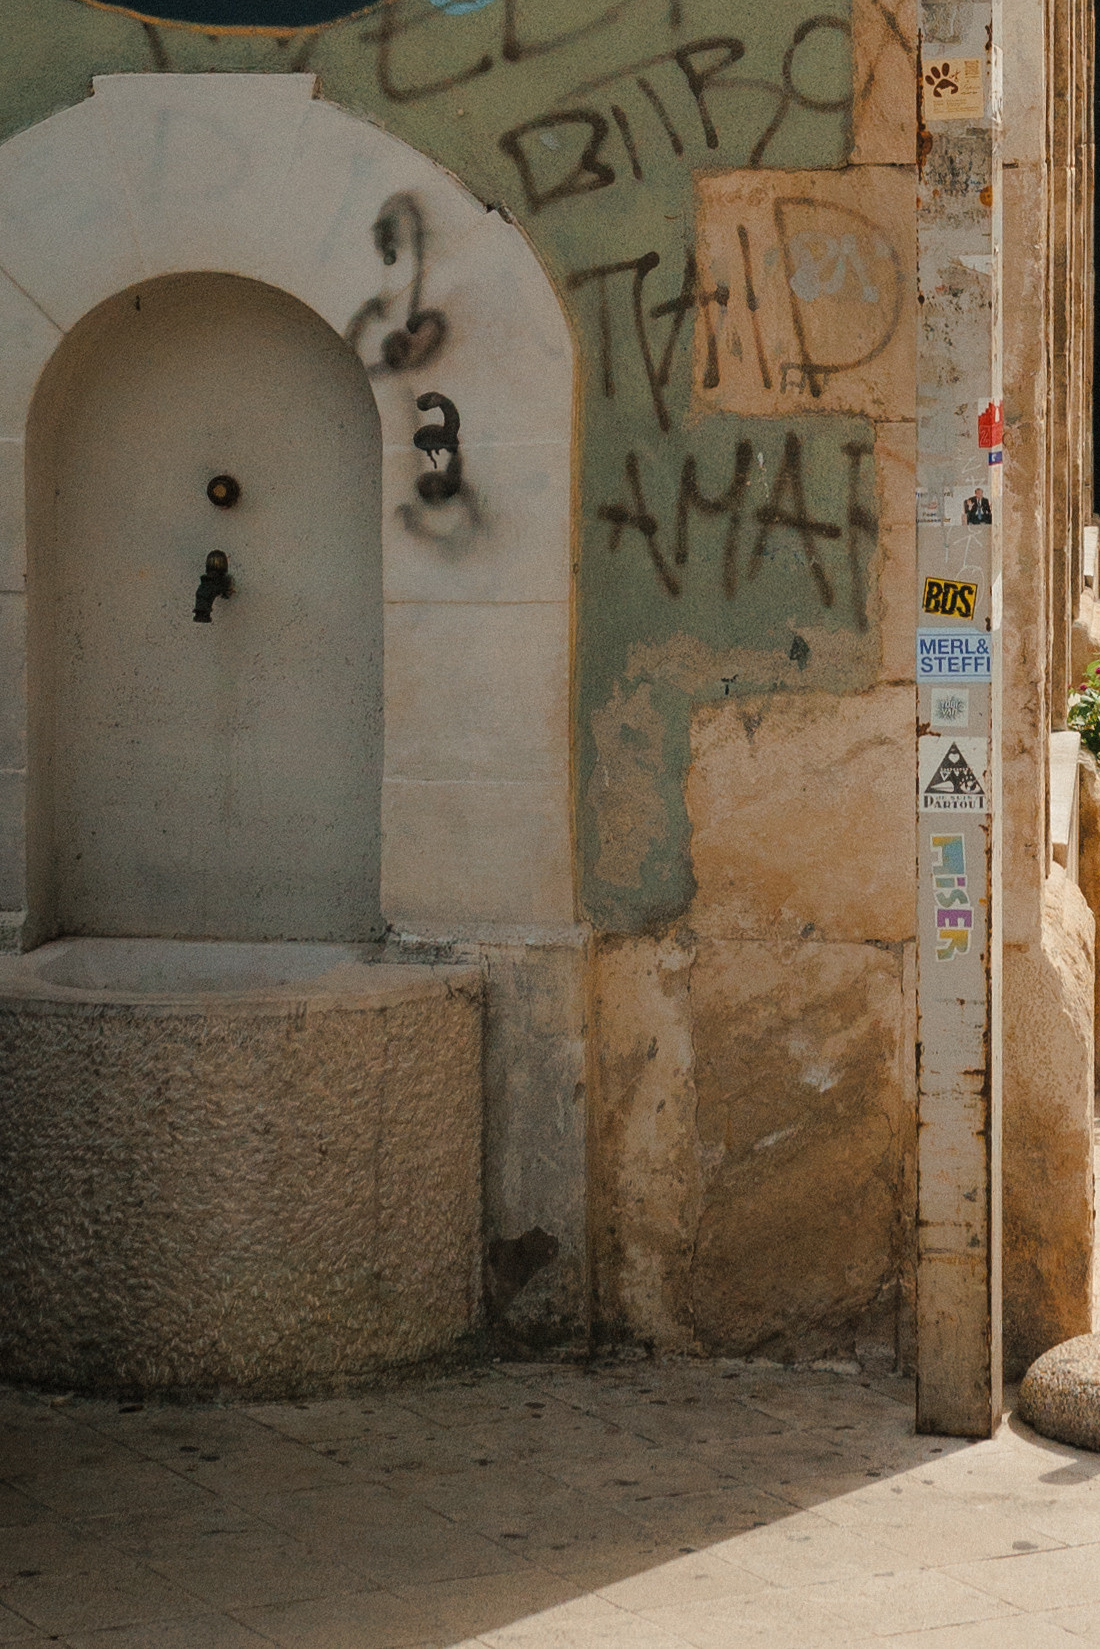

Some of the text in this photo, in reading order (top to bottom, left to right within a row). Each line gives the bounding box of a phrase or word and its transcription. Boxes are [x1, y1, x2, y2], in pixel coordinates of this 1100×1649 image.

[925, 581, 974, 618] BDS
[920, 638, 989, 655] MERL&
[920, 656, 991, 673] STEFFI
